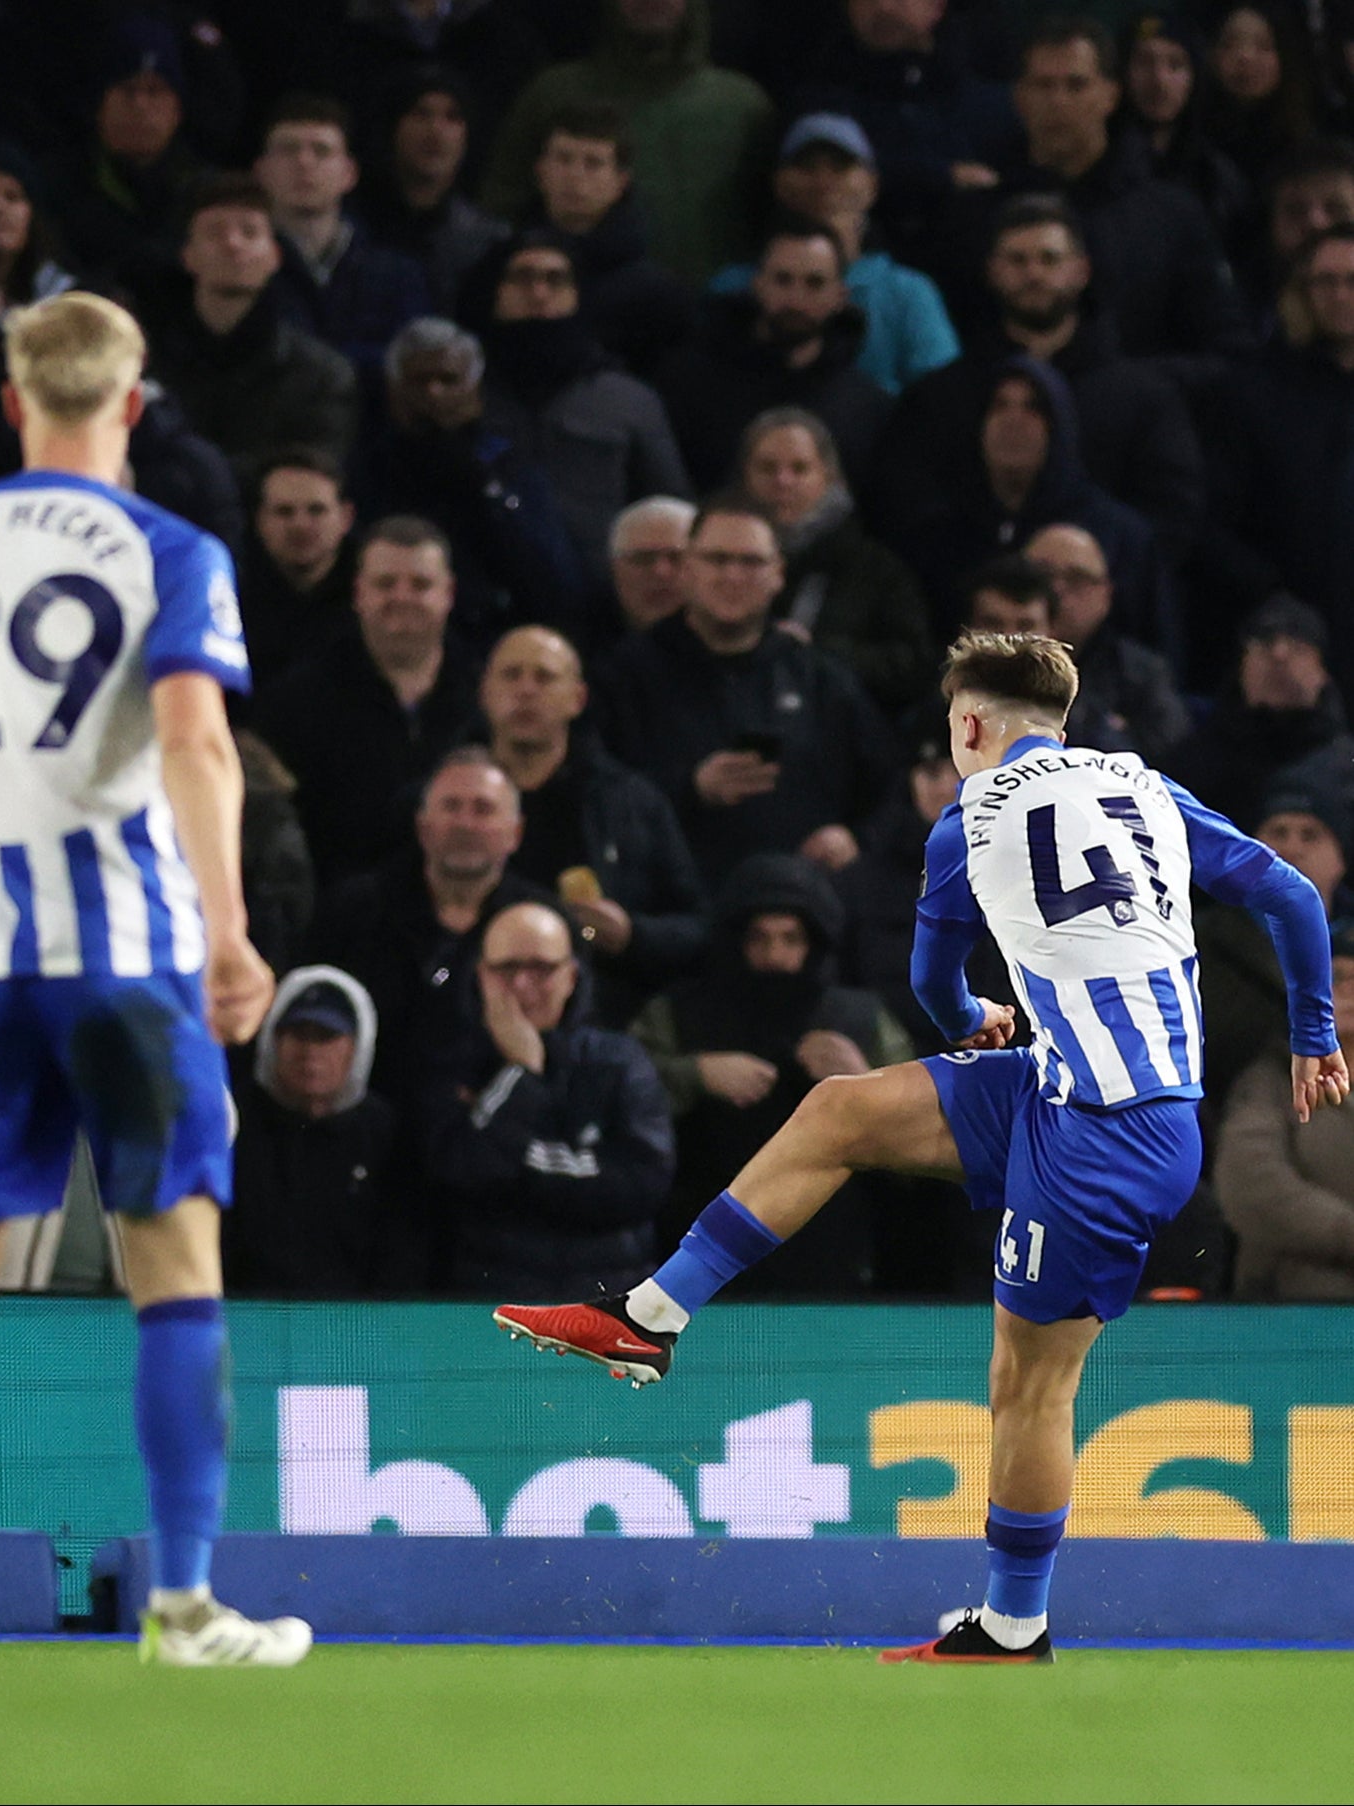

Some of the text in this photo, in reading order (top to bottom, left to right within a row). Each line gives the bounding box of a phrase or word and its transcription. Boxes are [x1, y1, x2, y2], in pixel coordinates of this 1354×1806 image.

[8, 502, 134, 563] HECKE
[1026, 796, 1174, 928] 41
[1000, 1207, 1045, 1283] 41
